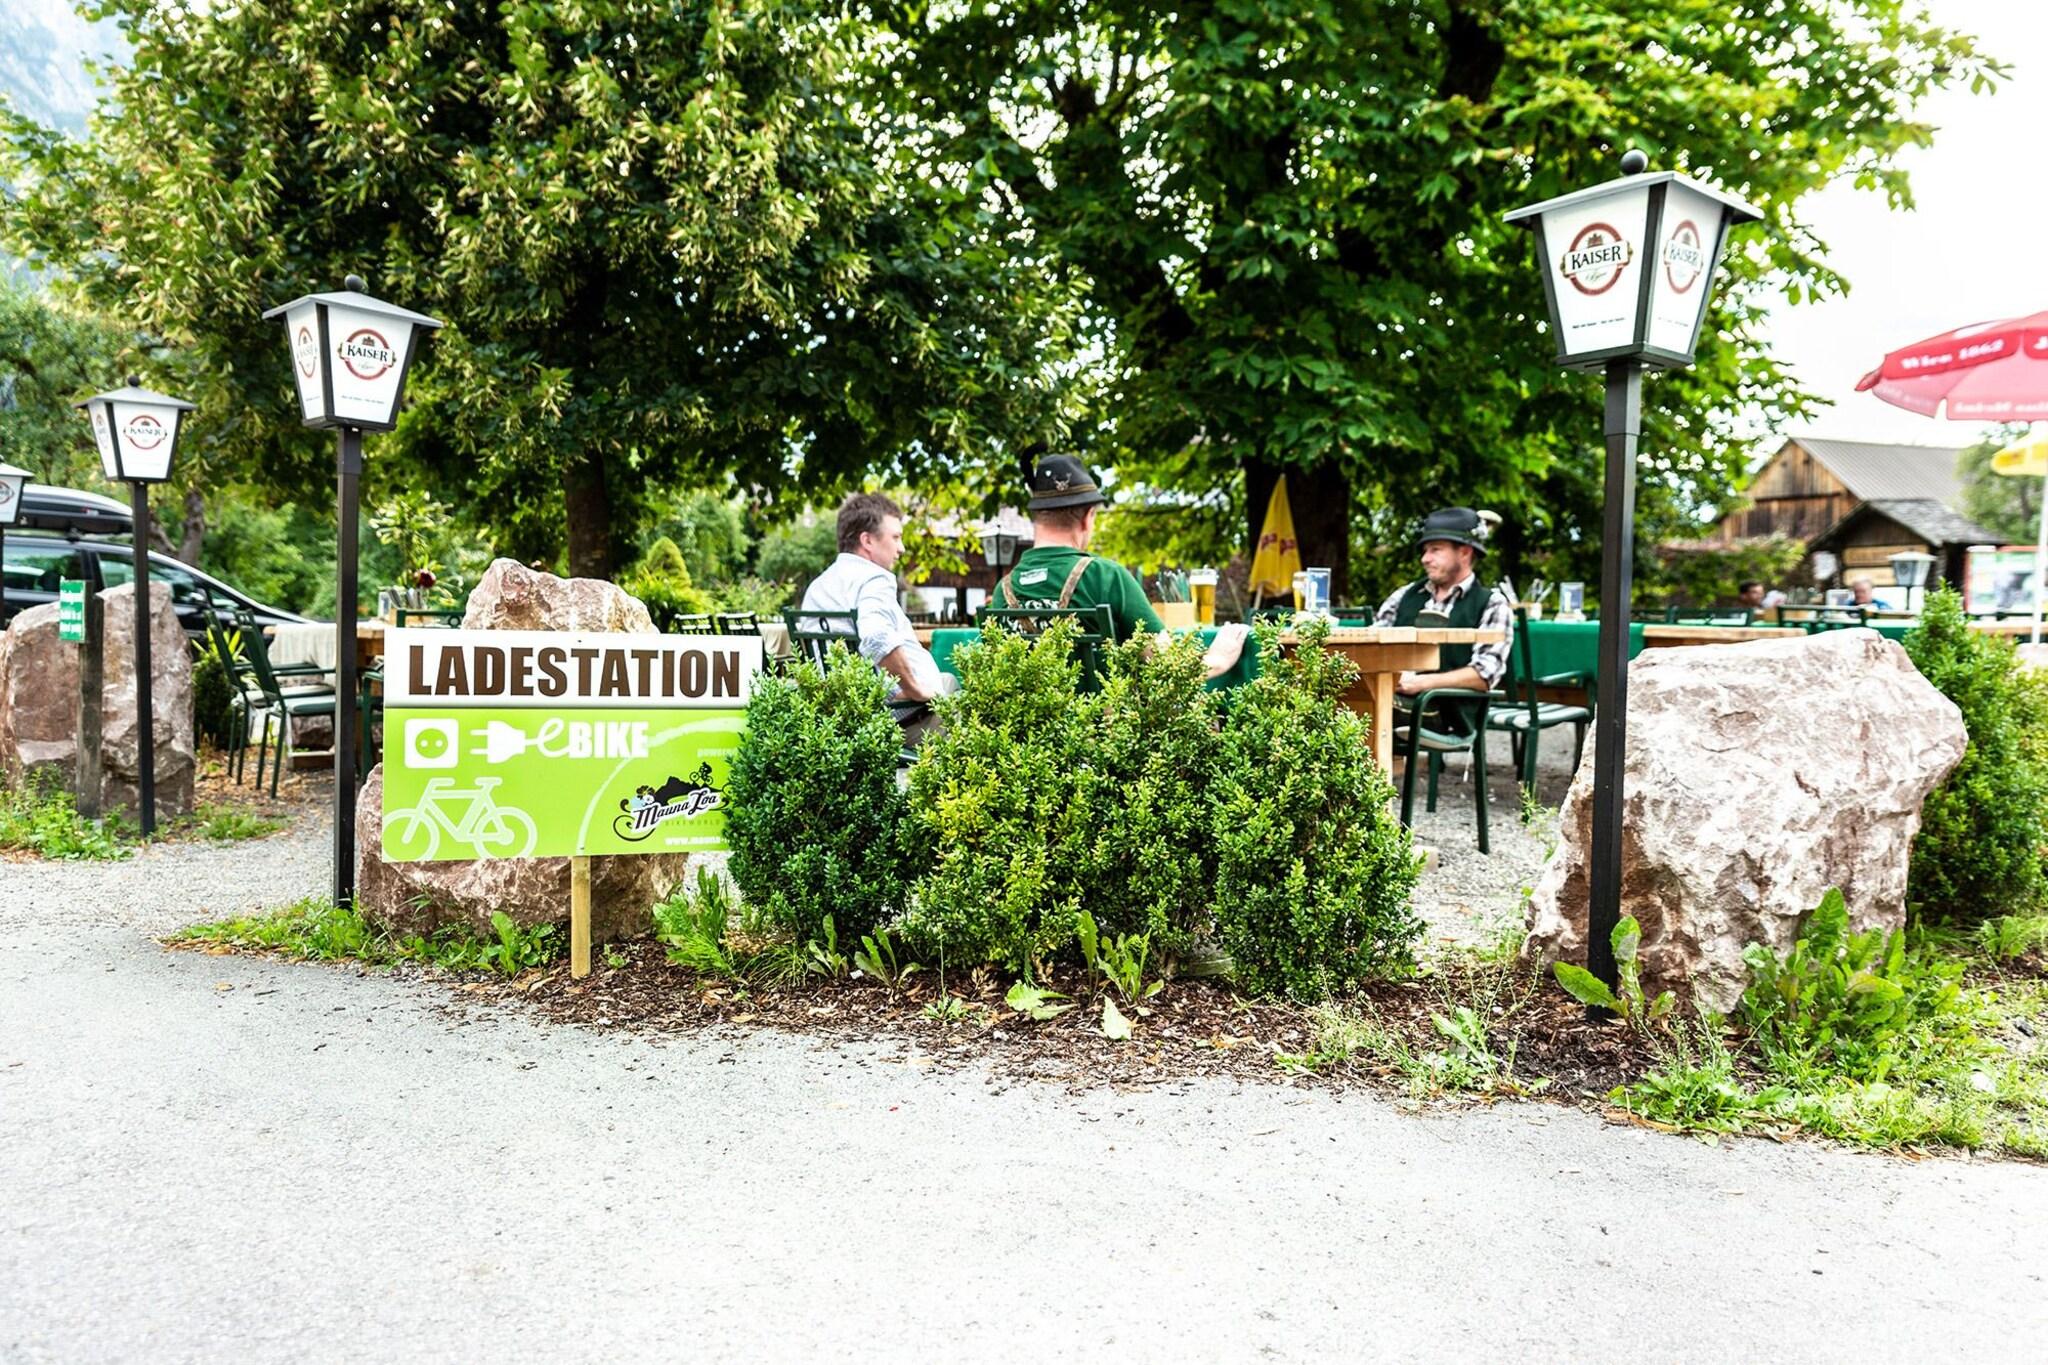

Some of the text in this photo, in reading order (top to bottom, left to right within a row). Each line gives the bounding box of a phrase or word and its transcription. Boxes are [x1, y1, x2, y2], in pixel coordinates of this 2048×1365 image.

[1571, 245, 1622, 270] KAISER
[346, 344, 388, 362] KAISER
[408, 645, 740, 698] LADESTATION
[633, 789, 718, 829] Mauna Loa
